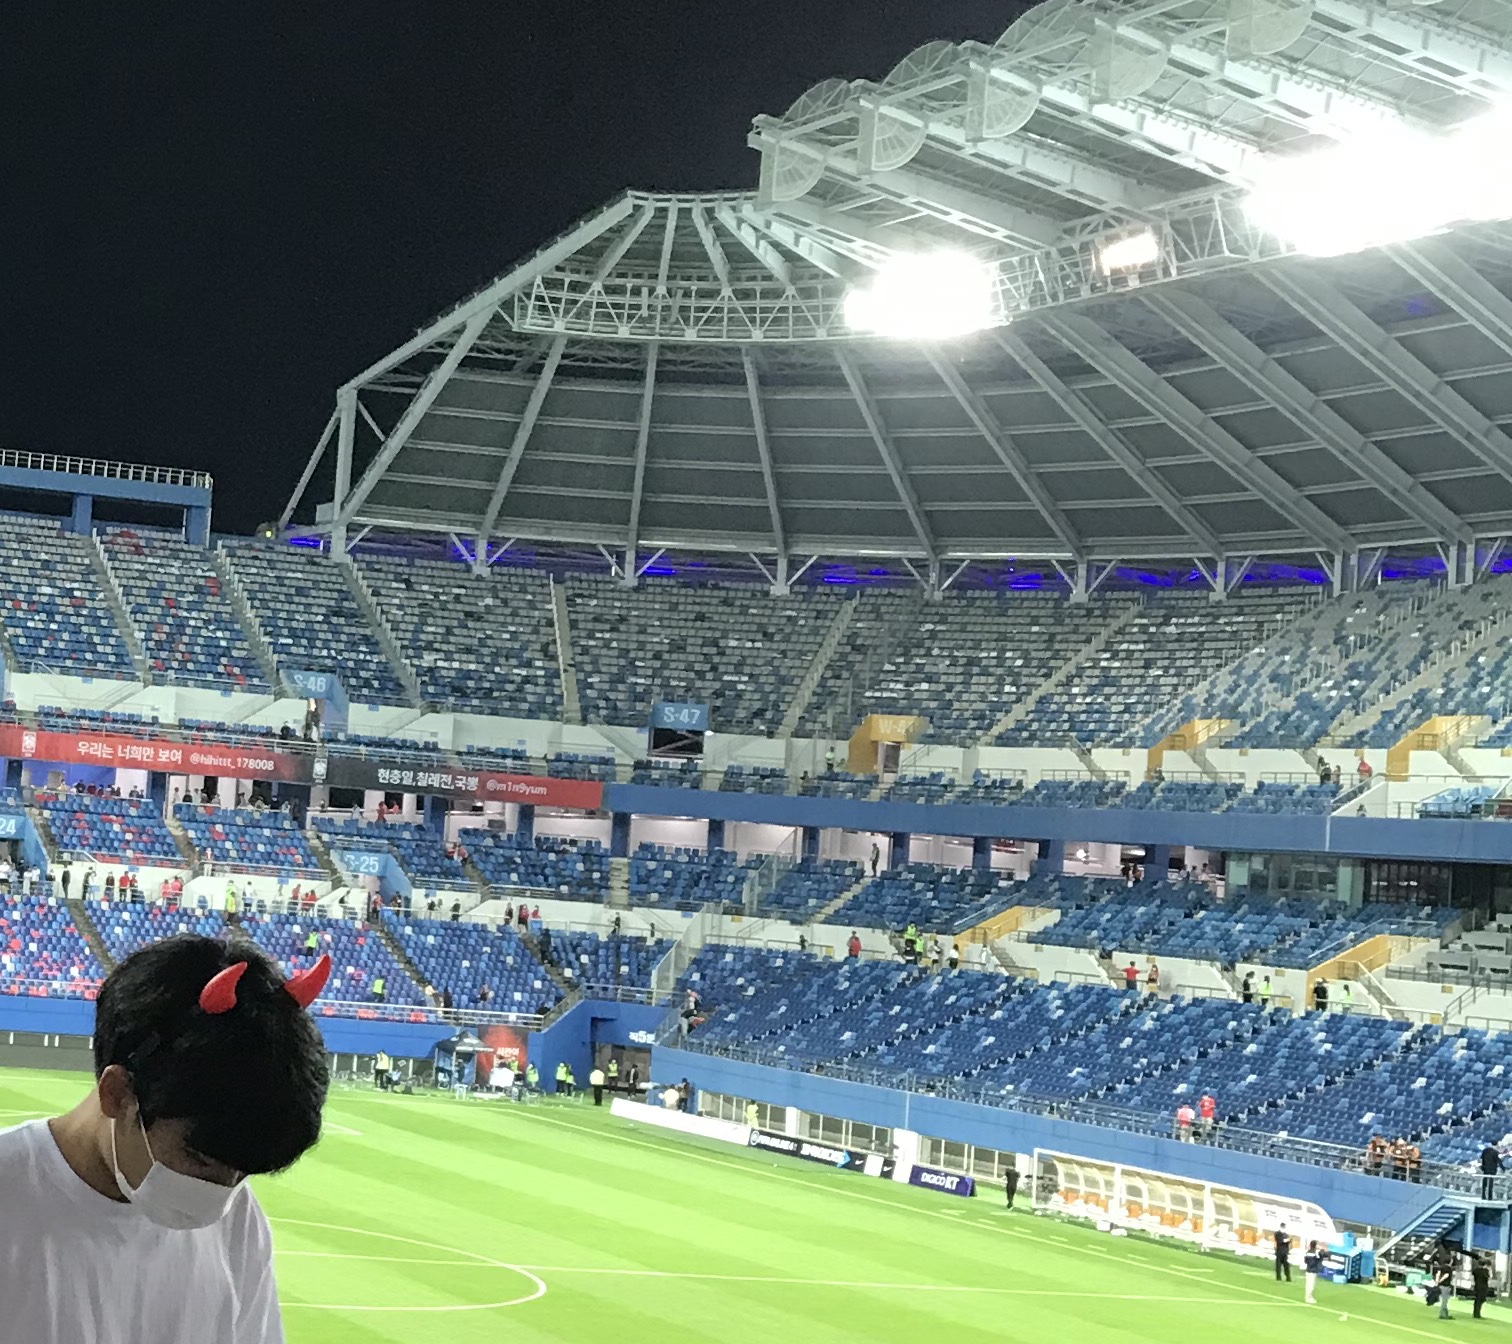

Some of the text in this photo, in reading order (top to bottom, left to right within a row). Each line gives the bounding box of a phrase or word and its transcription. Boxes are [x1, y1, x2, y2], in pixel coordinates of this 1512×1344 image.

[663, 707, 701, 726] S-47
[77, 740, 115, 759] 우리는
[117, 744, 155, 762] 너희만
[157, 748, 183, 765] 보여
